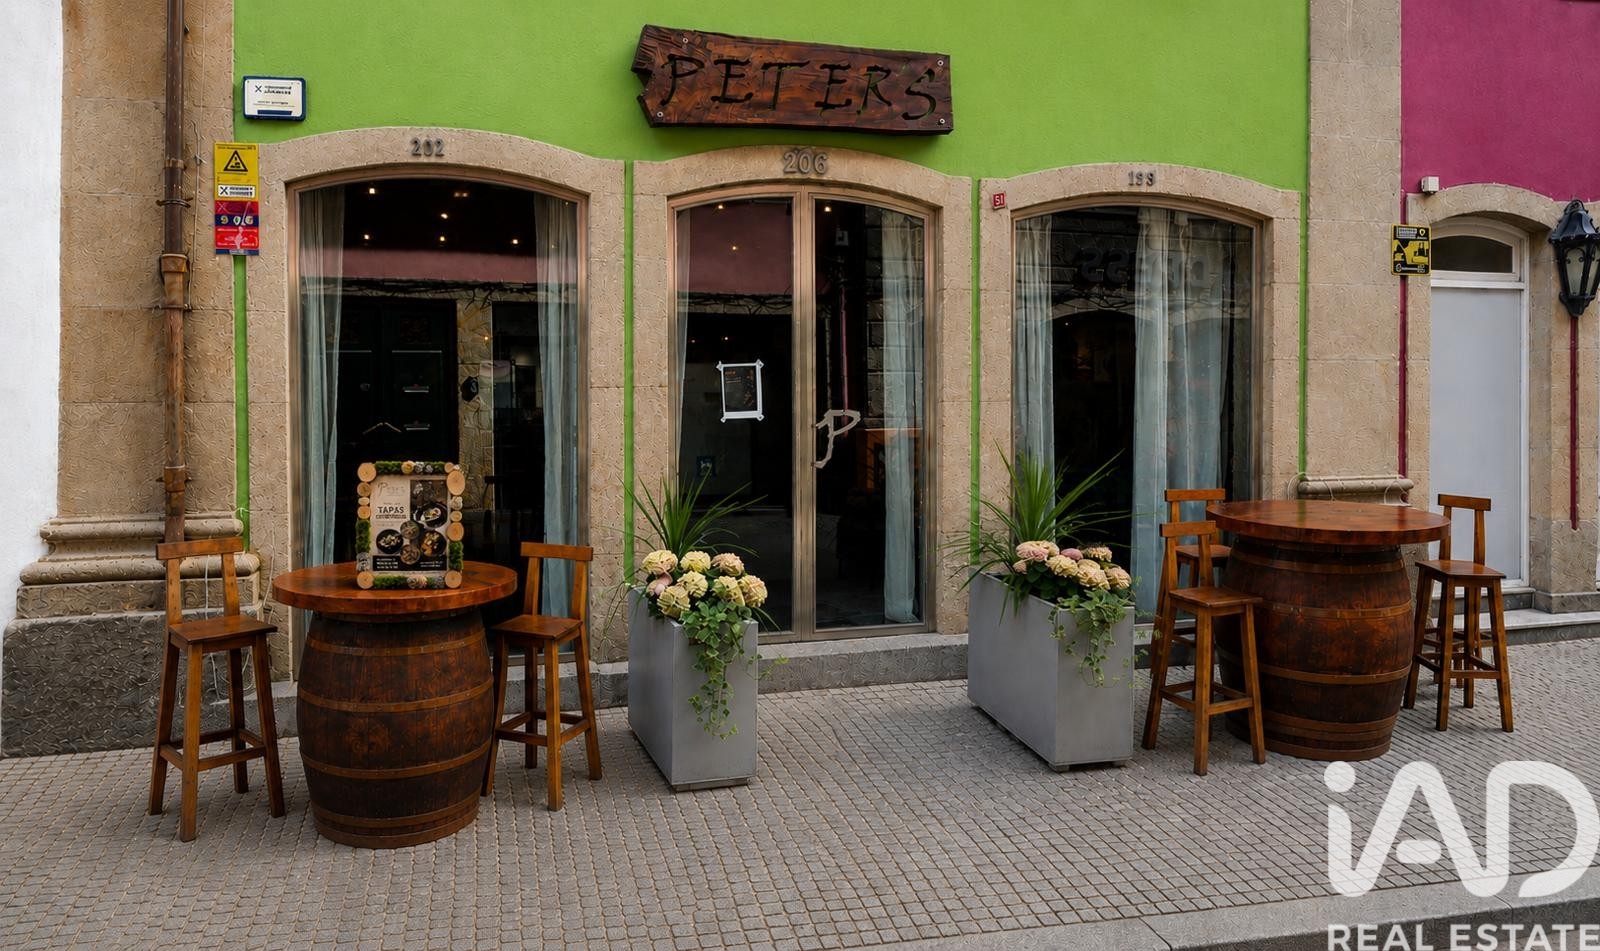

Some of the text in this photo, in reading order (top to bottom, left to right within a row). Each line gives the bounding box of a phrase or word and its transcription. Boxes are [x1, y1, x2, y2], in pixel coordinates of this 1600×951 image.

[660, 54, 936, 120] PETERS
[410, 137, 445, 157] 202
[783, 150, 828, 175] 206
[378, 506, 404, 514] TAPAS
